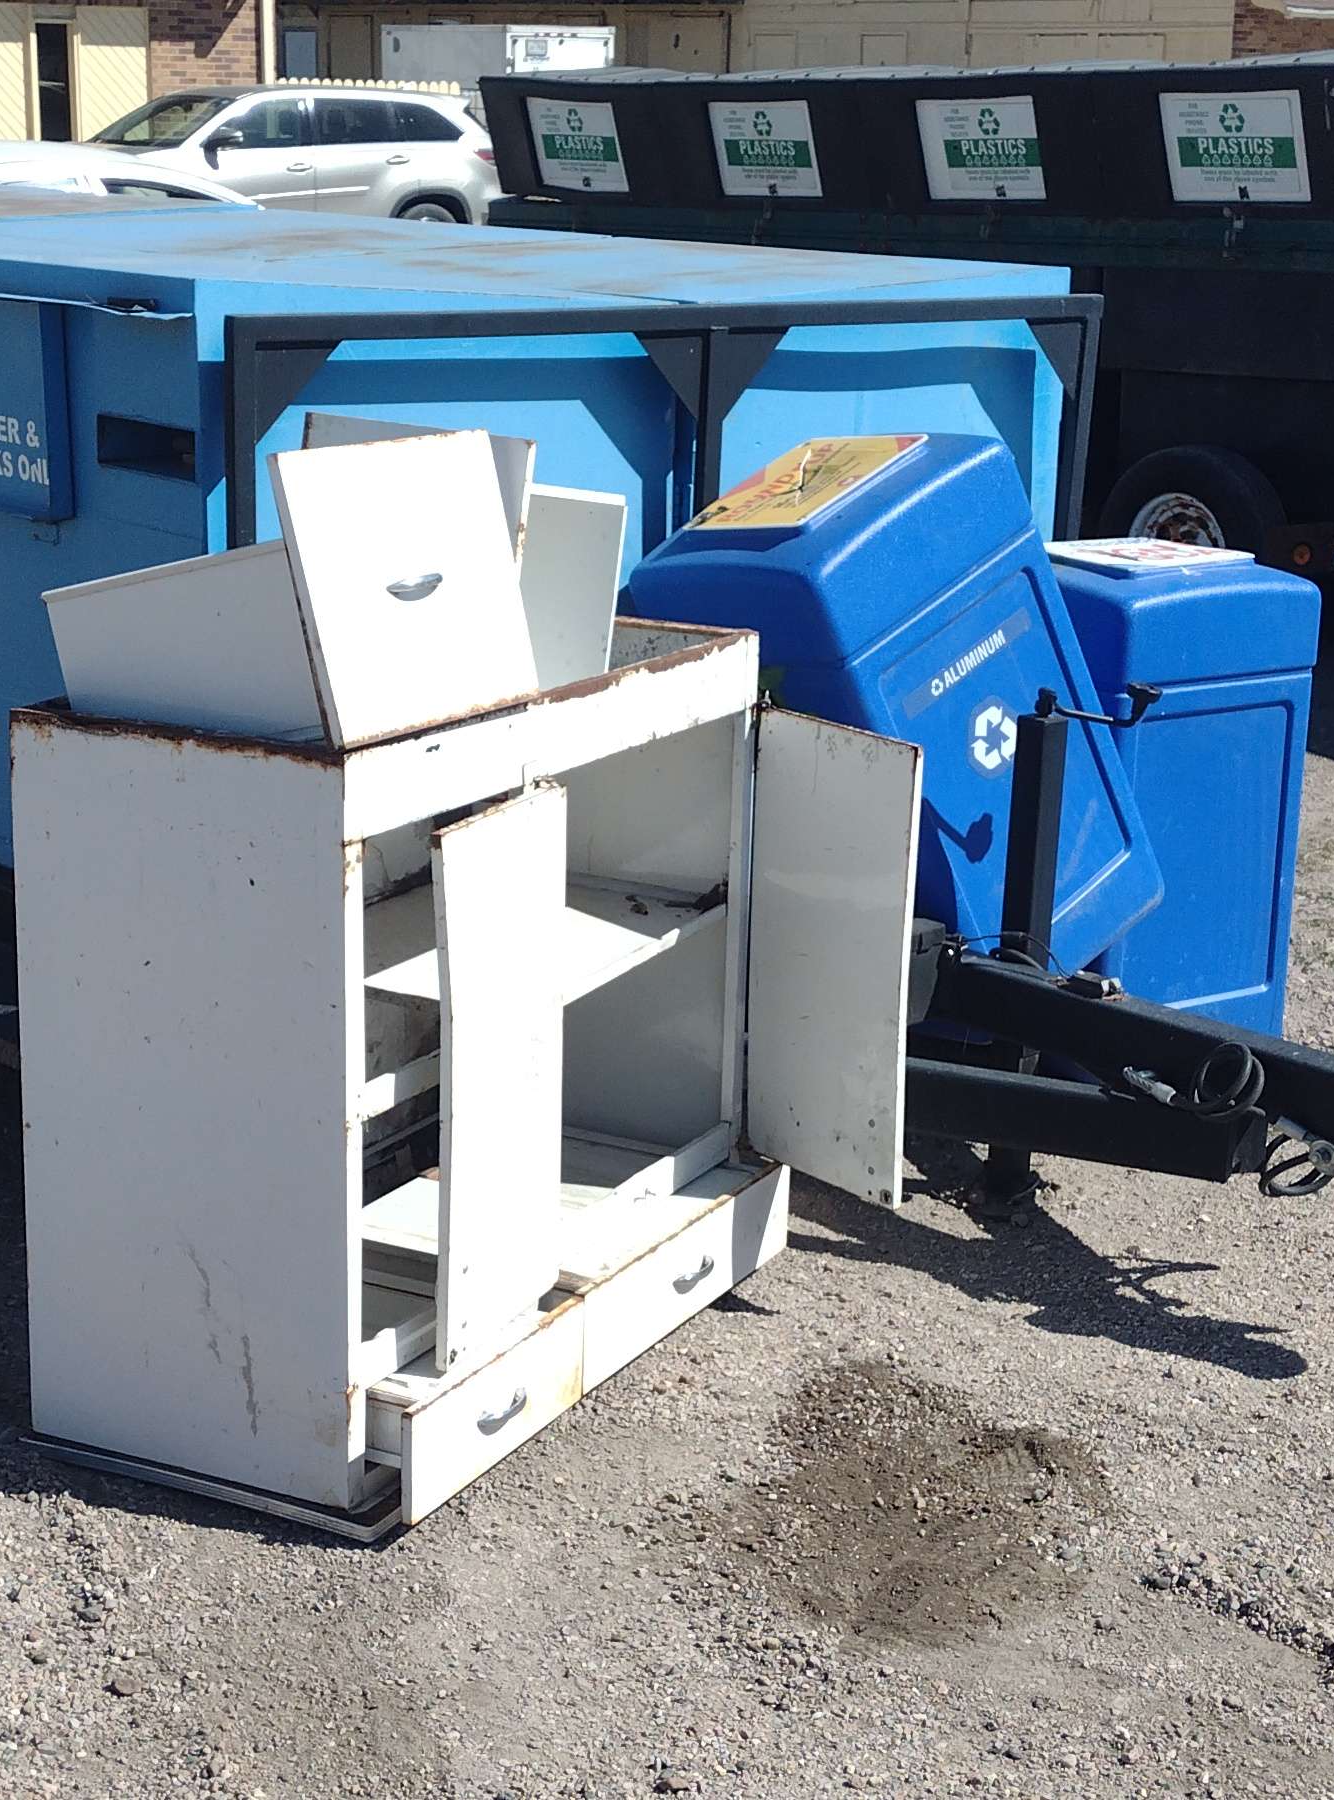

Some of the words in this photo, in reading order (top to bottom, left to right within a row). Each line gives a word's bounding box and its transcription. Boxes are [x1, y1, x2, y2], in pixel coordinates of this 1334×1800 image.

[553, 134, 605, 151] PLASTICS
[738, 140, 796, 156] PLASTICS
[960, 139, 1027, 156] PLASTICS
[1197, 137, 1275, 155] PLASTICS
[25, 420, 40, 449] &
[942, 628, 1007, 690] ALUMINUM
